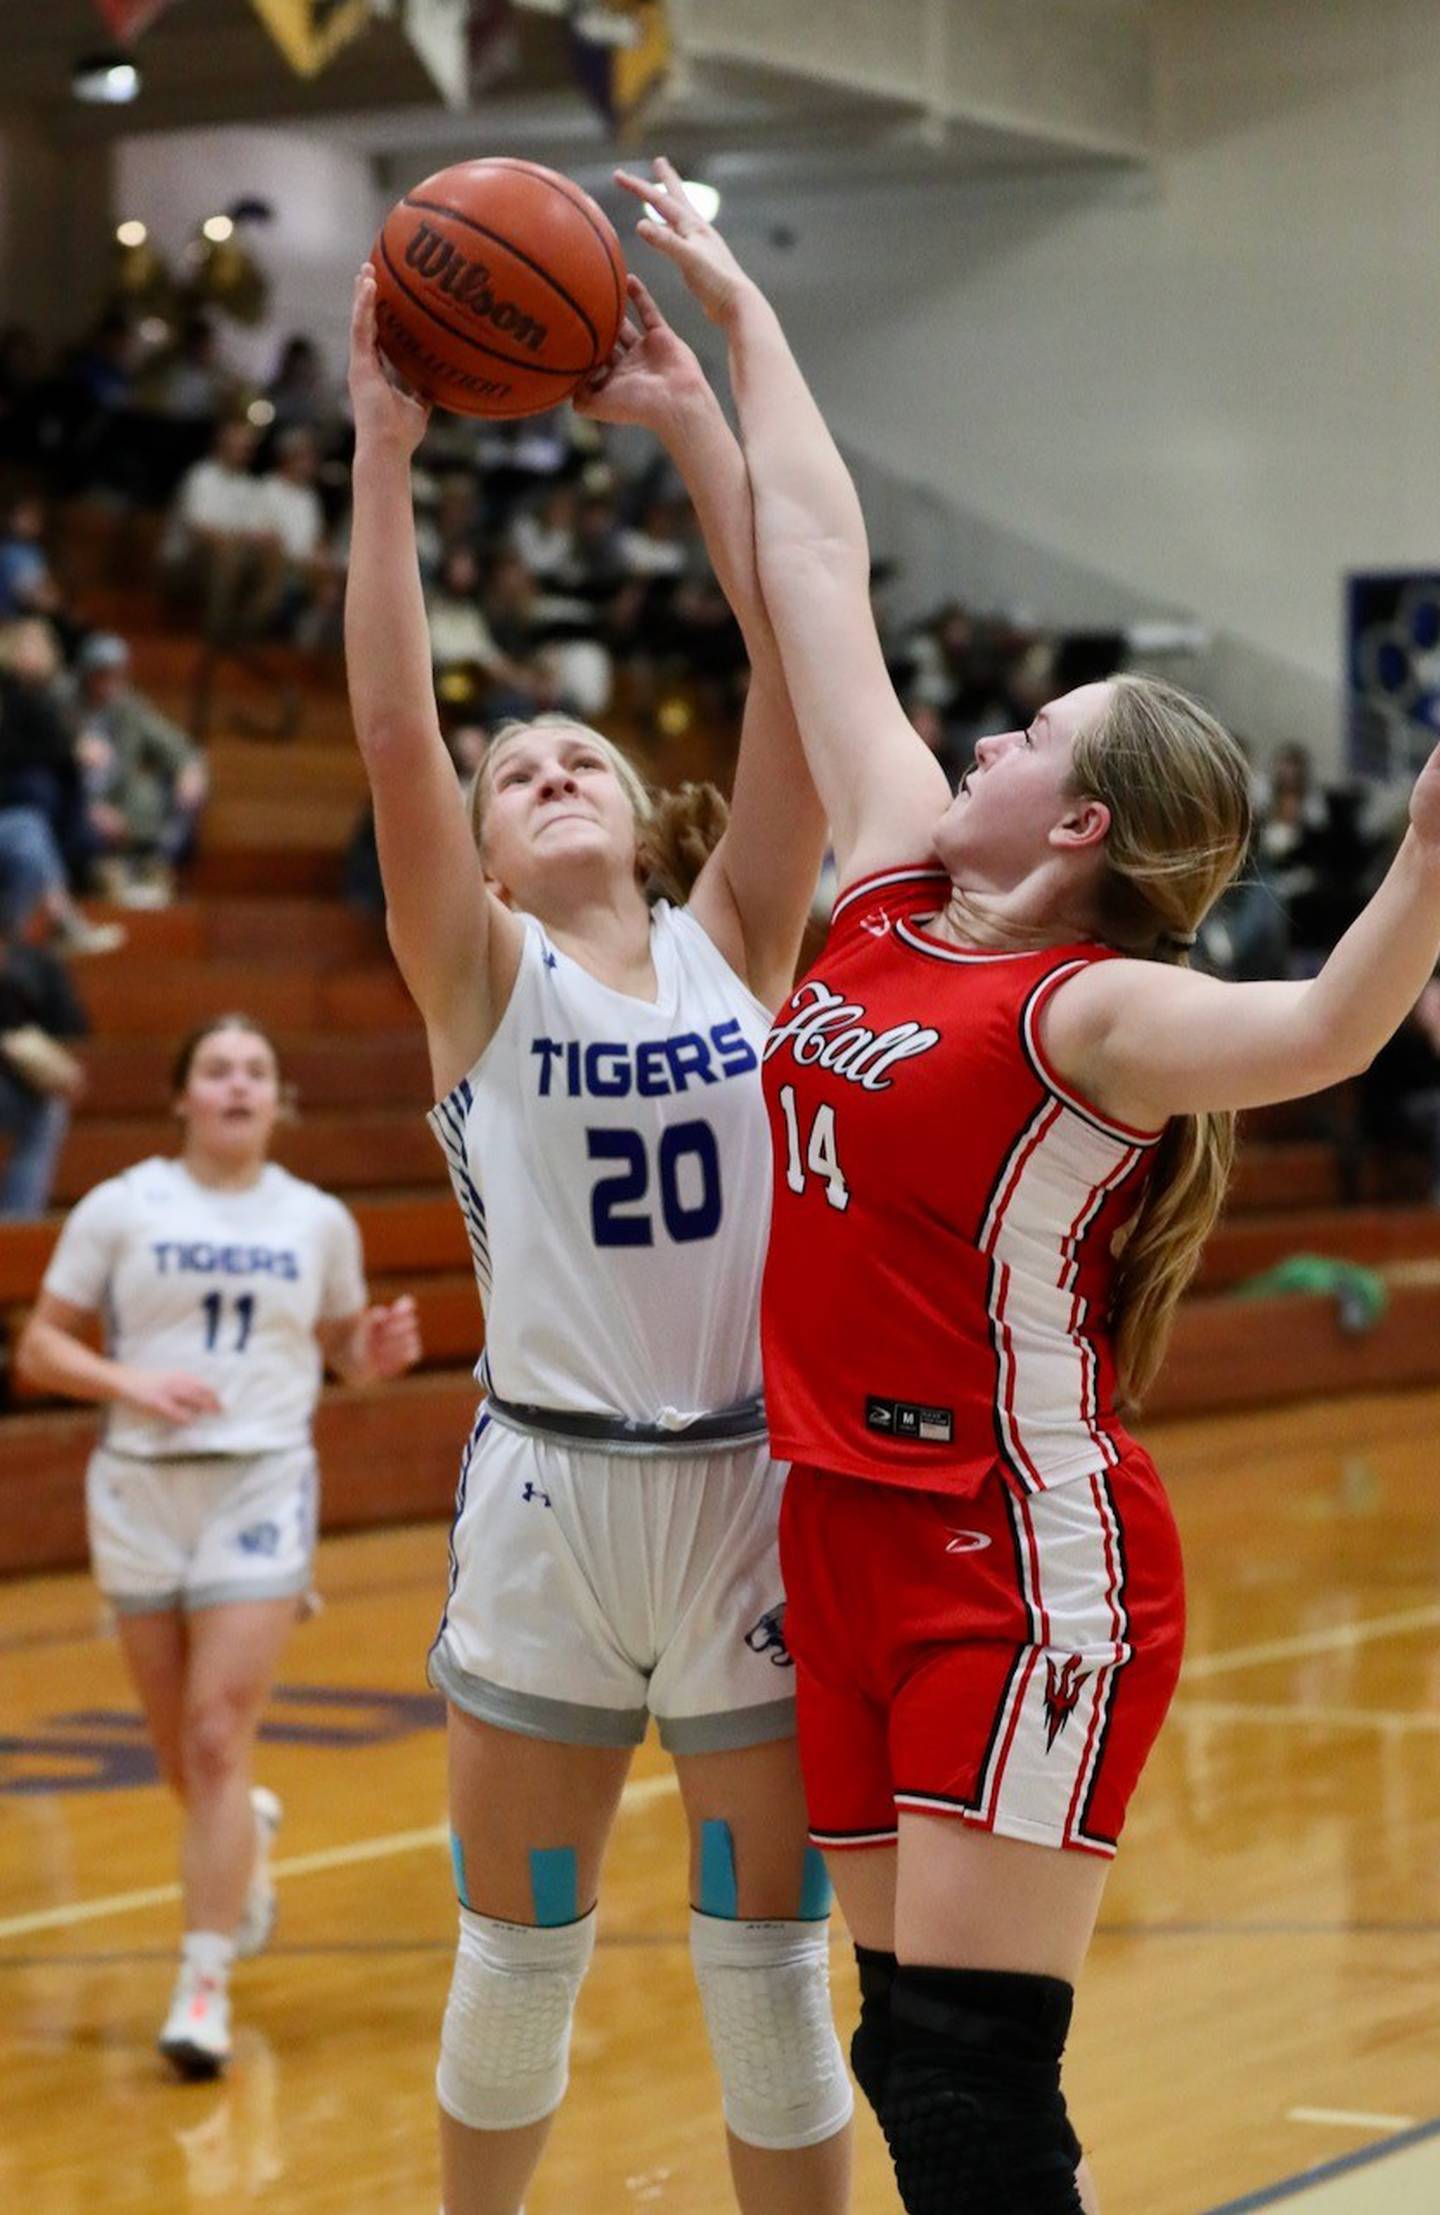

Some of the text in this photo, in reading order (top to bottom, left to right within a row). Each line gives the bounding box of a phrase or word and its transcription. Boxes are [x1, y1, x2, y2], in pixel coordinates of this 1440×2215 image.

[404, 221, 547, 351] Wilson
[531, 1018, 759, 1098] TIGERS
[765, 980, 940, 1092] Hall
[585, 1117, 724, 1248] 20
[779, 1084, 850, 1212] 14
[152, 1241, 299, 1282] TIGERS
[203, 1290, 255, 1353] 11
[902, 1411, 915, 1425] M
